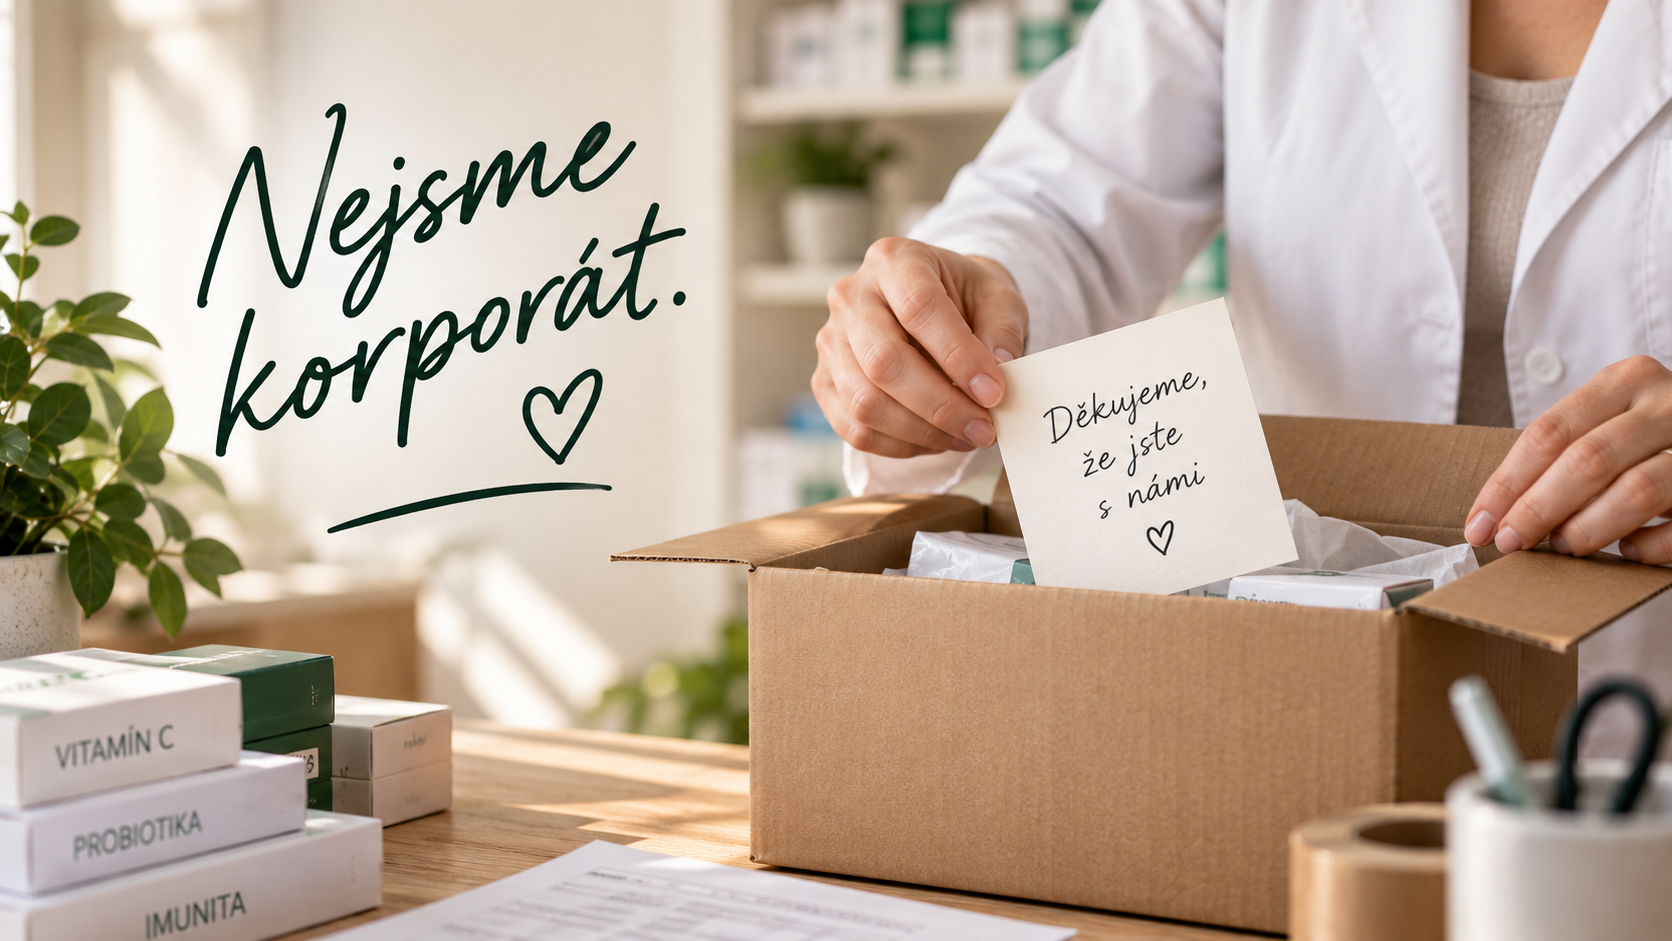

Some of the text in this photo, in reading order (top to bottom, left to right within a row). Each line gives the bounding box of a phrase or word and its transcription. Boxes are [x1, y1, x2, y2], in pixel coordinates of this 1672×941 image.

[1042, 371, 1207, 445] Děkujeme,
[1082, 421, 1183, 478] že jste
[1098, 462, 1206, 520] s námi
[54, 723, 175, 770] VITAMÍN C
[72, 810, 204, 862] PROBIOTIKA
[144, 890, 248, 940] IMUNITA
